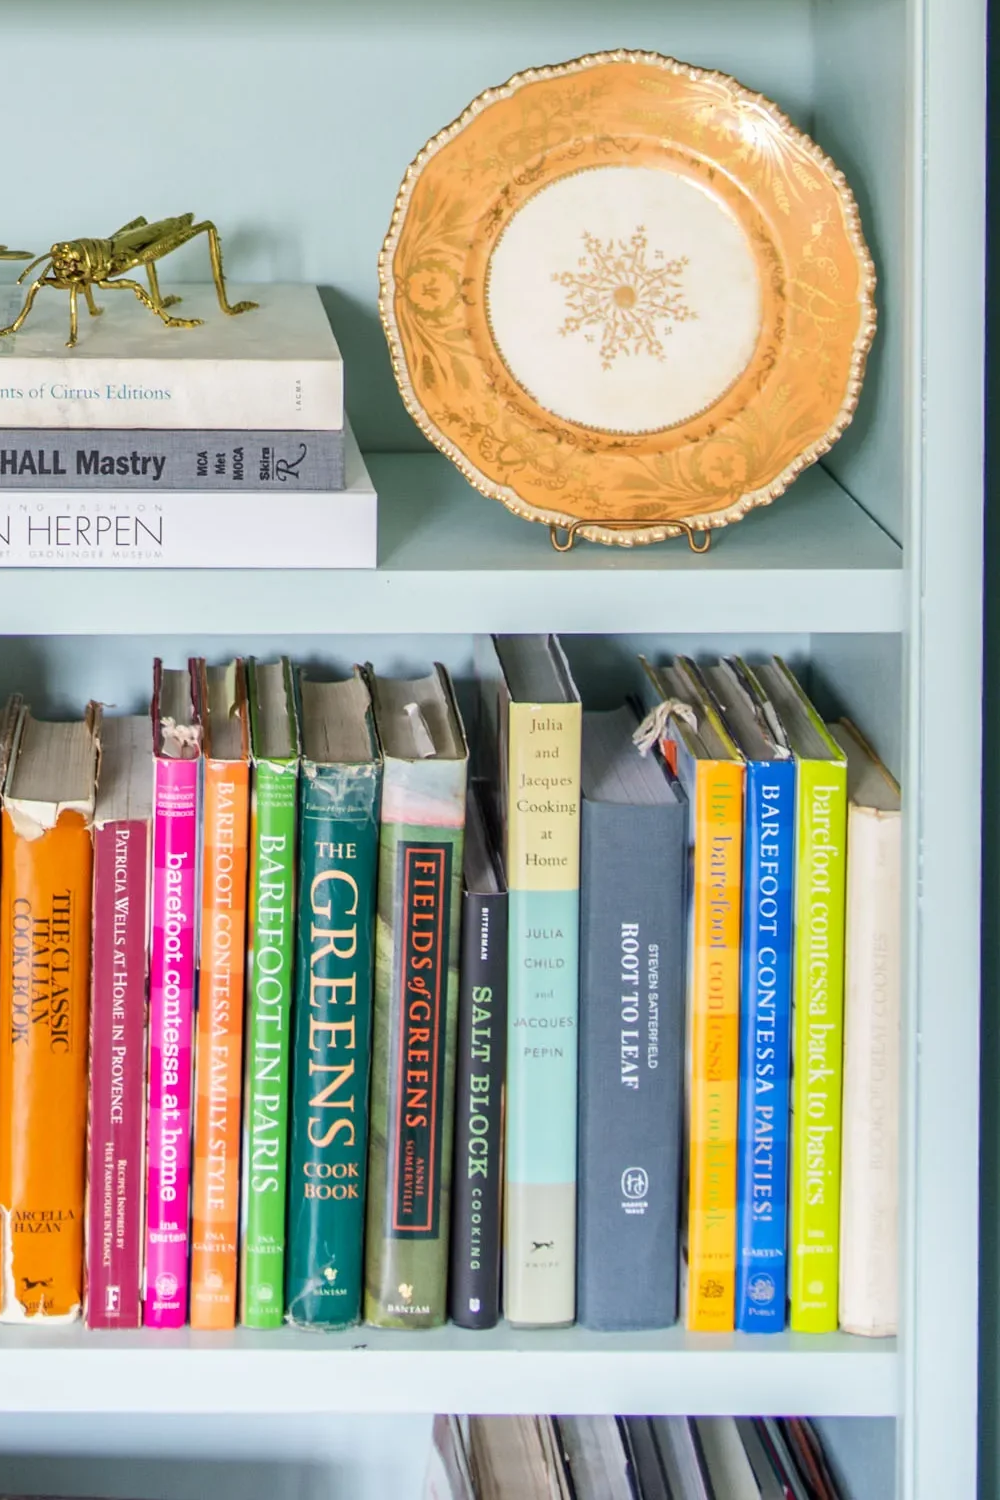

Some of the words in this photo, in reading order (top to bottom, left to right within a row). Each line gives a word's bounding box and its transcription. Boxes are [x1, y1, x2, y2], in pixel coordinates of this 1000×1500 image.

[30, 384, 46, 401] of
[50, 384, 100, 402] Cirrus
[106, 383, 171, 402] Editions
[76, 448, 166, 480] Mastry
[197, 450, 208, 477] MCA
[215, 452, 227, 474] Met
[28, 515, 164, 545] HERPEN
[531, 718, 563, 732] Julia
[517, 799, 577, 815] Cooking
[520, 774, 573, 789] Jacques
[114, 830, 130, 893] PATRICIA
[316, 842, 357, 859] THE
[525, 853, 568, 868] Home
[760, 784, 780, 934] BAREFOOT
[11, 898, 30, 965] COOK
[51, 889, 71, 947] THE
[113, 897, 129, 946] WELLS
[164, 852, 185, 964] barefoot
[411, 860, 434, 969] FIELDS
[31, 917, 50, 1025] ITALIAN
[113, 951, 128, 968] AT
[621, 923, 639, 985] ROOT
[648, 945, 659, 990] STEVEN
[11, 973, 30, 1045] BOOK
[50, 950, 71, 1053] CLASSIC
[112, 973, 128, 1019] HOME
[308, 870, 359, 1149] GREENS
[407, 977, 433, 998] of
[621, 992, 639, 1023] TO
[112, 1024, 126, 1040] IN
[162, 971, 182, 1088] contessa
[471, 986, 492, 1062] SALT
[647, 994, 659, 1068] SATTERFIELD
[756, 947, 778, 1094] CONTESSA
[110, 1046, 127, 1123] PROVENCE
[406, 1001, 432, 1129] GREENS
[620, 1030, 639, 1088] LEAF
[161, 1094, 180, 1121] at
[468, 1074, 490, 1178] BLOCK
[160, 1127, 181, 1200] home
[304, 1162, 359, 1178] COOK
[753, 1104, 774, 1221] PARTIES!
[304, 1184, 359, 1200] BOOK
[470, 1188, 481, 1269] COOKING
[387, 1304, 429, 1313] BANTAM
